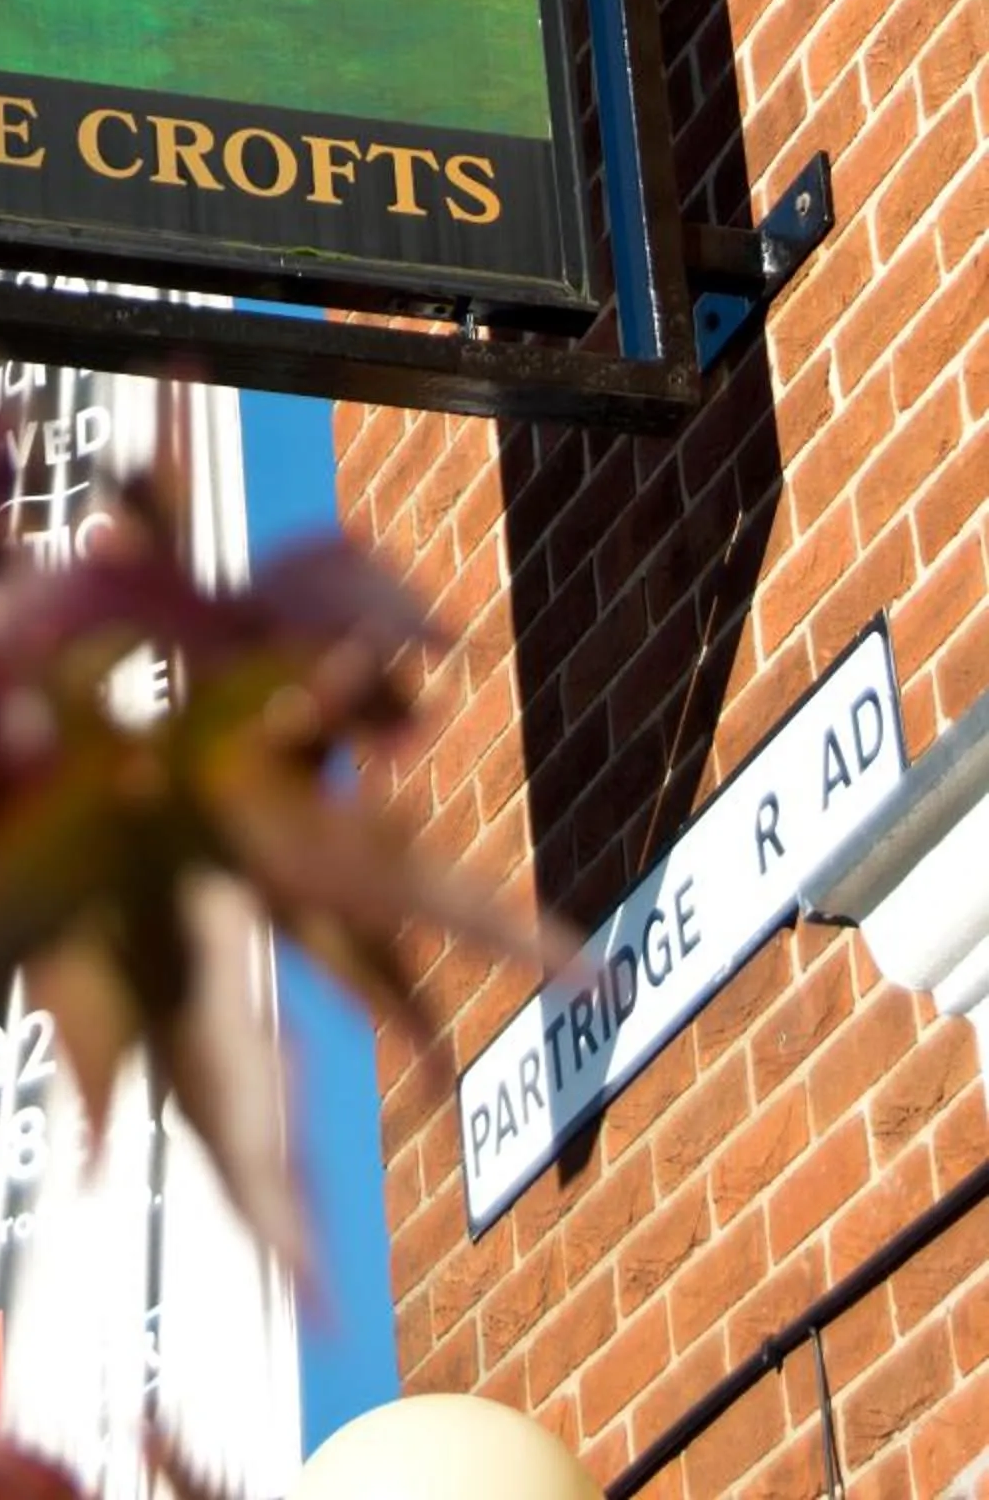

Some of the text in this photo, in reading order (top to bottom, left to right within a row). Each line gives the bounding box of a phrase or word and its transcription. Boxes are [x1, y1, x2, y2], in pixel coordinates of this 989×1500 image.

[77, 108, 501, 224] CROFTS
[469, 686, 884, 1179] PARTRIDGE RAD
